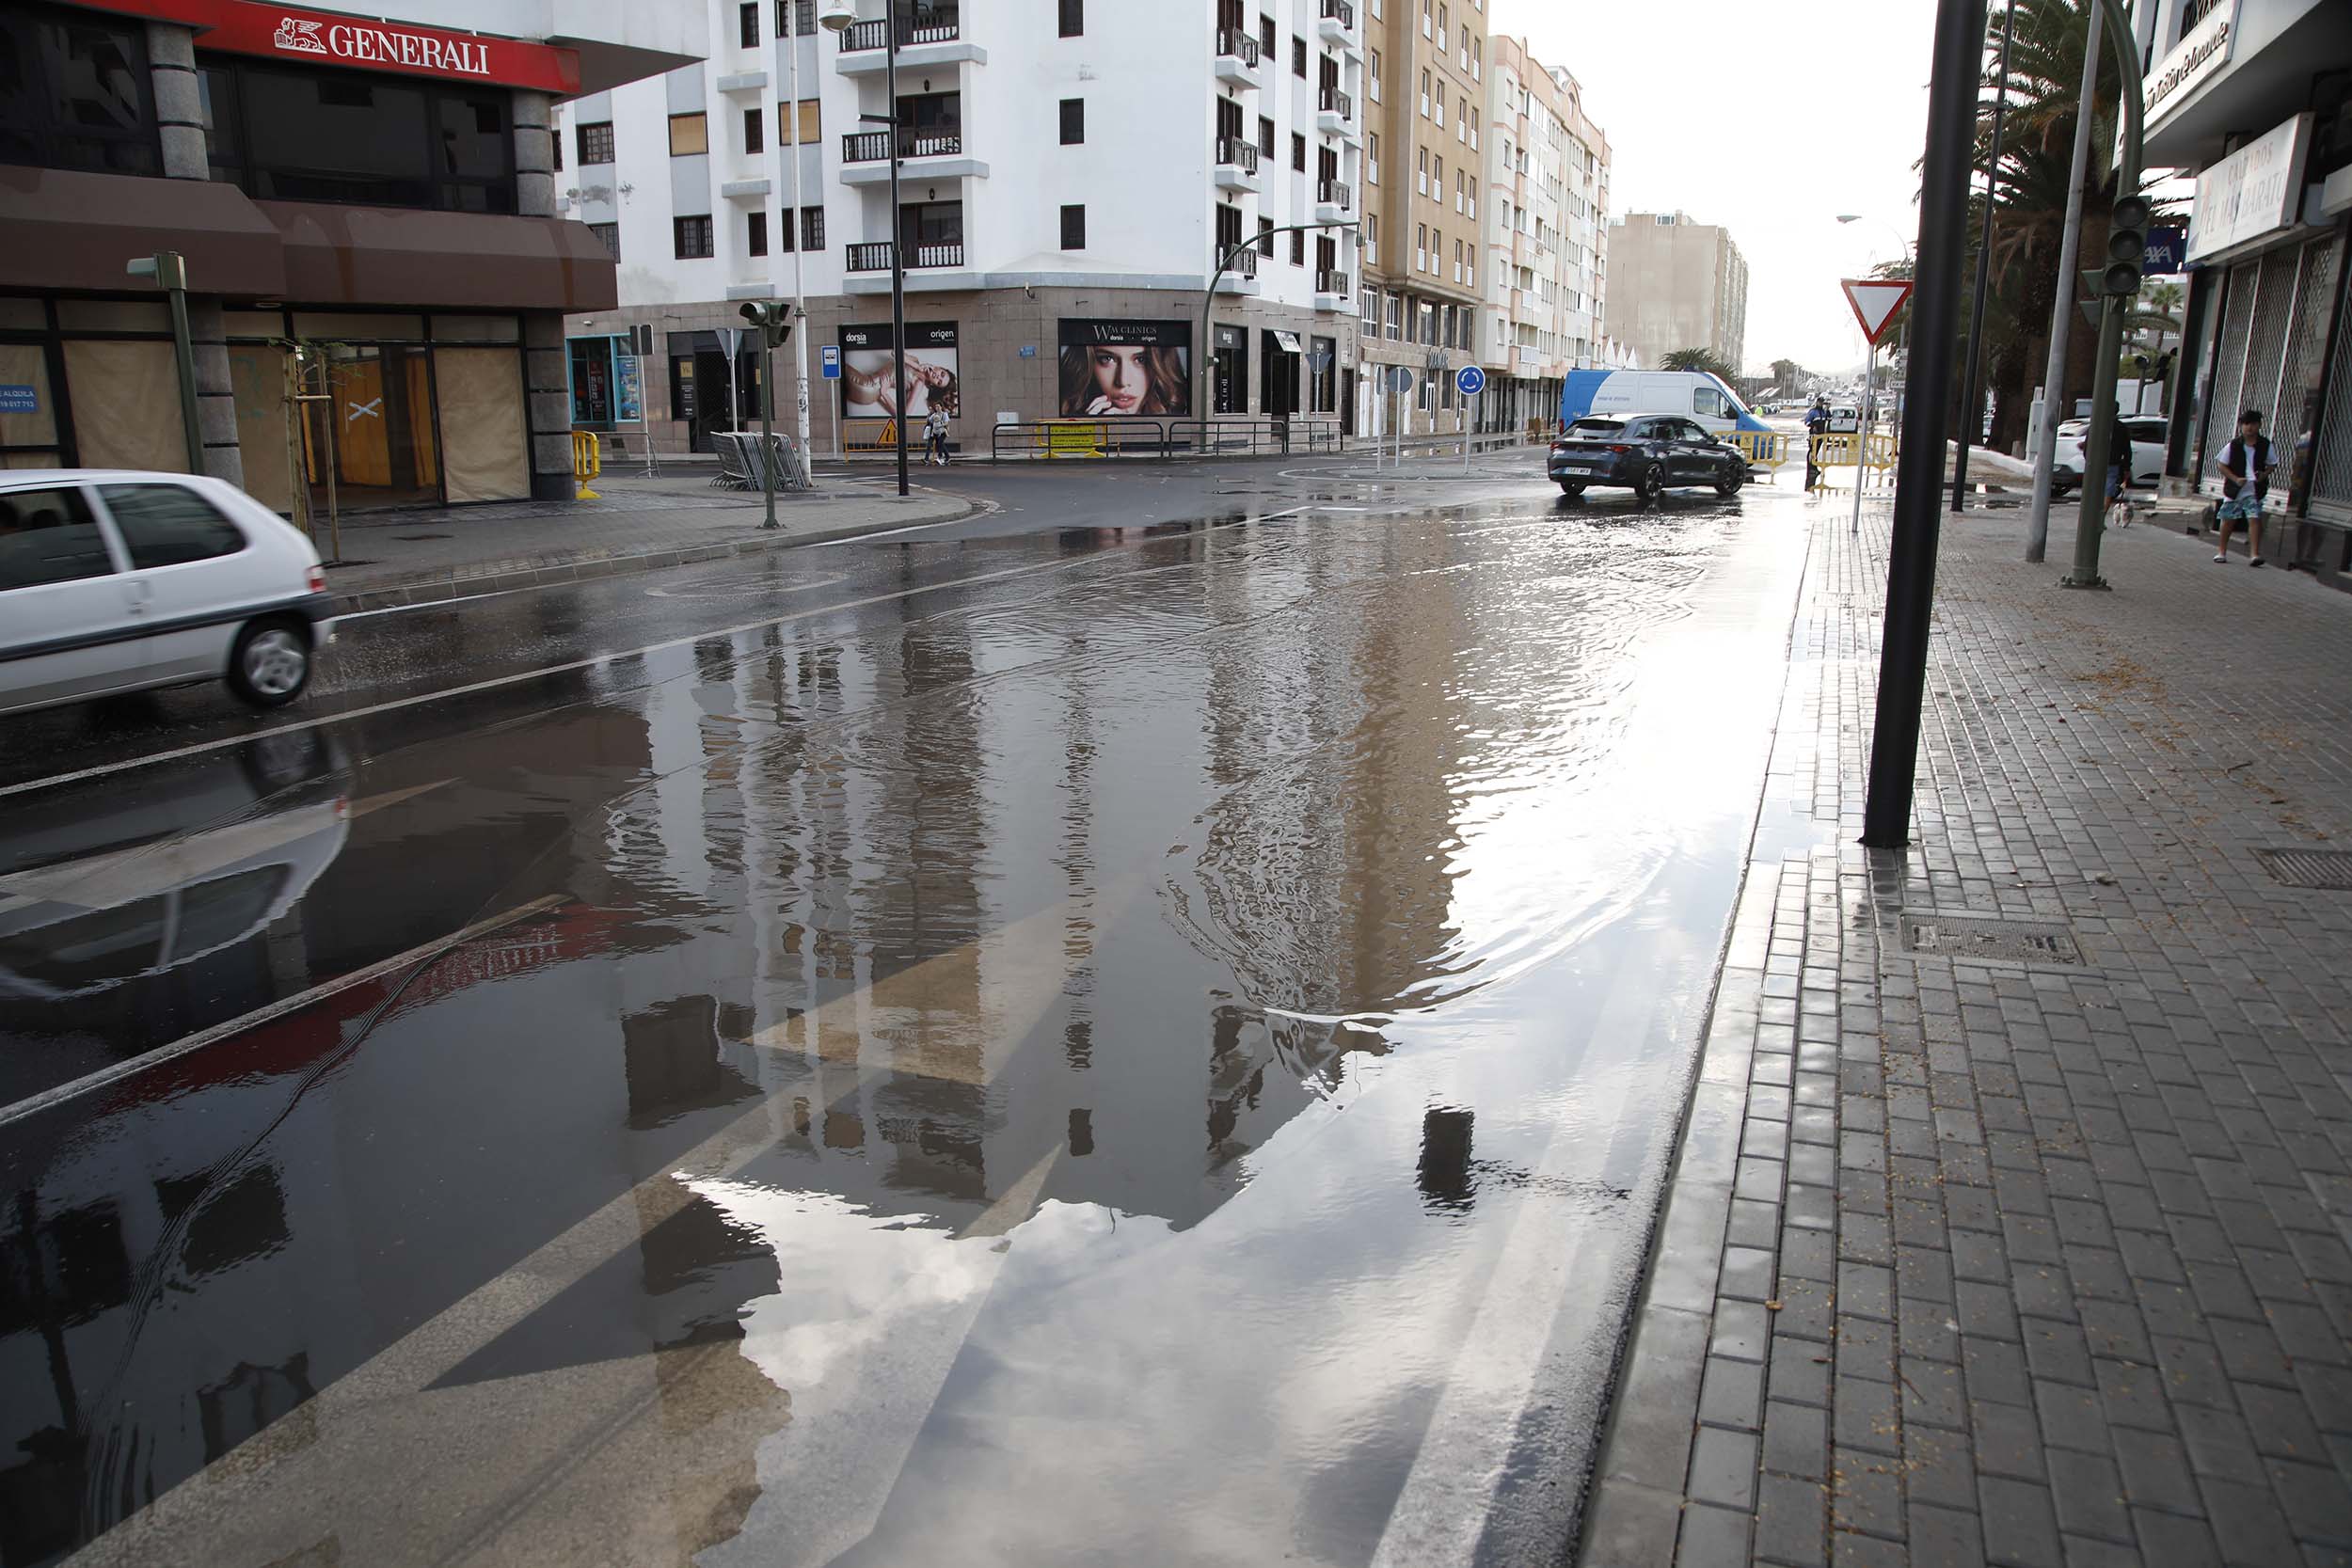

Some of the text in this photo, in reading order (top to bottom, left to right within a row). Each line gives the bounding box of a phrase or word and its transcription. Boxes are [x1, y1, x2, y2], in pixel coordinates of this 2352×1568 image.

[328, 24, 490, 75] GENERALI
[2144, 245, 2172, 263] AXA
[846, 332, 866, 341] dorsia
[930, 329, 954, 340] origen
